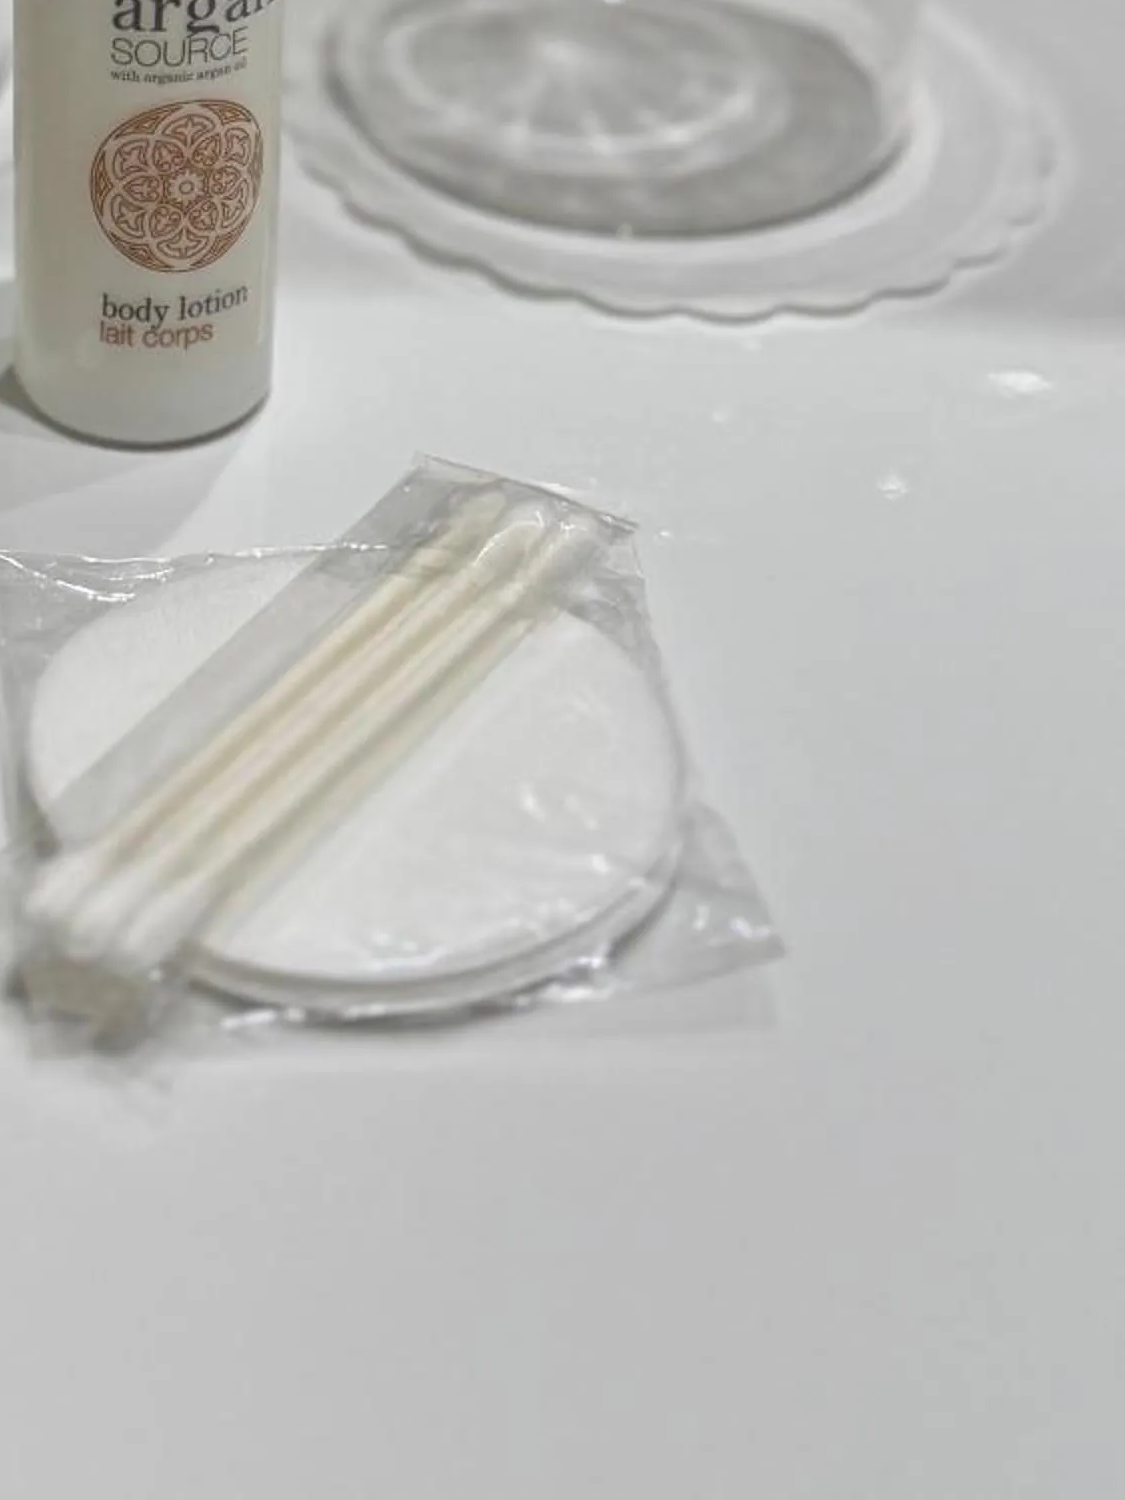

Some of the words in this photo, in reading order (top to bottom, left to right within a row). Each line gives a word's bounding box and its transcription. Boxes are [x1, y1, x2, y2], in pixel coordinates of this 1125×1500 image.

[110, 27, 249, 67] SOURCE
[110, 69, 141, 83] with
[143, 71, 194, 85] organic
[196, 64, 231, 82] argan
[101, 292, 171, 328] body
[178, 285, 250, 321] lotion
[98, 320, 134, 347] lait
[141, 323, 215, 351] corps
